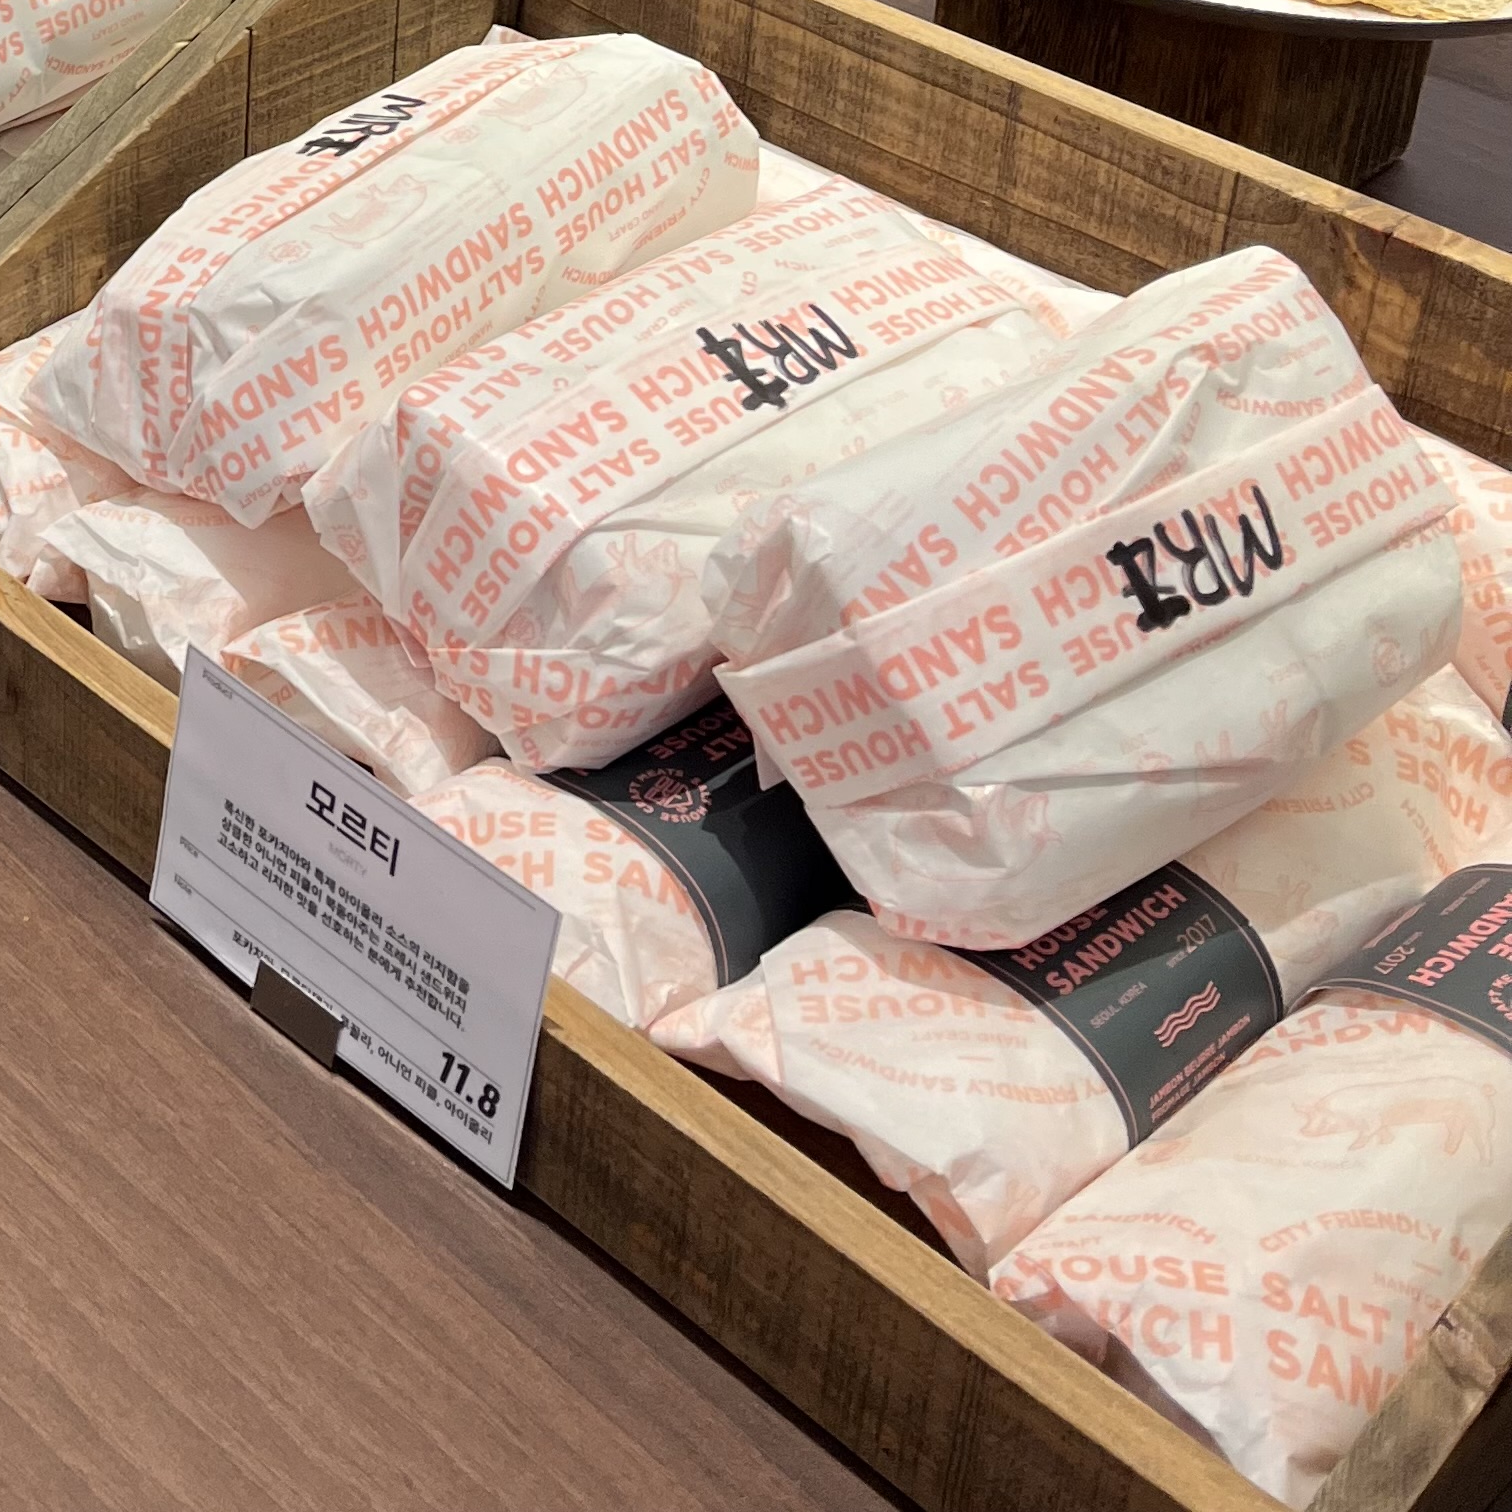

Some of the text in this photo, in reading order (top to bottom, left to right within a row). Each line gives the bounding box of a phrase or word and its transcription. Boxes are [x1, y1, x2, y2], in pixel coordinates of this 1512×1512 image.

[357, 88, 689, 349] SANDWICH SANDWICH
[281, 134, 710, 443] SALT HOUSE SALT HOUSE SALT
[654, 249, 736, 294] SALT
[541, 286, 662, 364] HOUSE
[458, 291, 974, 631] HOUSE SALT HOUSE
[954, 345, 1158, 533] SANDWICH
[996, 301, 1301, 558] HOUSE SALT HOUSE
[424, 398, 629, 593] SANDWICH
[792, 459, 1414, 791] HOUSE SALT HOUSE
[756, 604, 1025, 749] SANDWICH
[702, 726, 751, 762] ALT
[304, 775, 400, 878] 모르티
[1396, 750, 1489, 835] HOUSE
[216, 830, 259, 874] 고소하고
[384, 920, 420, 959] 소스의
[1010, 905, 1109, 971] HOUSE
[1045, 884, 1187, 996] SANDWICH
[1177, 913, 1218, 955] 2017
[1374, 944, 1416, 976] 2017
[1407, 892, 1512, 987] ANDWICH
[797, 990, 986, 1024] HOUSE
[1119, 981, 1149, 1009] KOREA
[437, 1046, 502, 1126] 11.8
[1063, 1212, 1217, 1246] SANDWICH
[1258, 1208, 1445, 1253] CITY FRIENDLY
[1260, 1271, 1392, 1344] SALT
